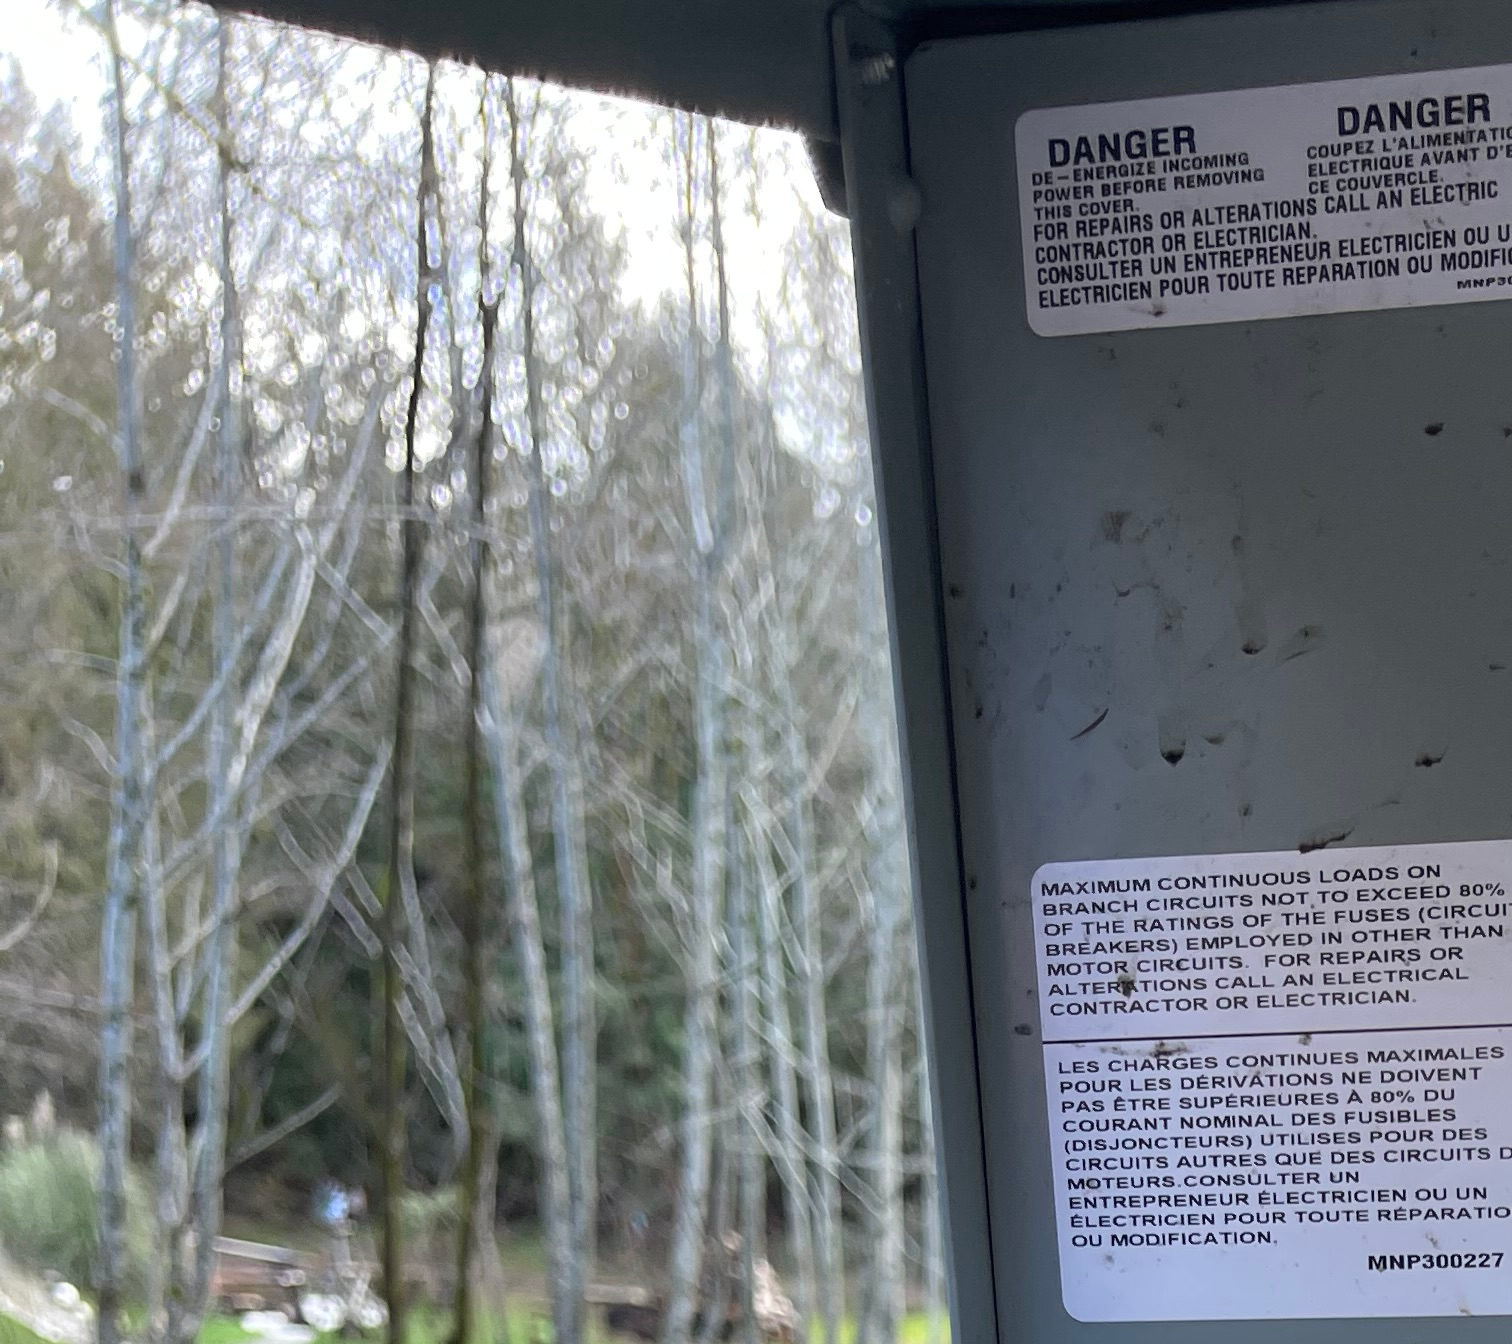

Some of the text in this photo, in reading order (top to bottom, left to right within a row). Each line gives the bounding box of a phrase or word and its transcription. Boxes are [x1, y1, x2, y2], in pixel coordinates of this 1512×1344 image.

[1337, 93, 1491, 137] DANGER
[1048, 125, 1197, 168] DANGER
[1163, 152, 1250, 174] INCOMING
[1306, 140, 1374, 160] COUPEZ
[1307, 153, 1414, 178] ELECTRIQUE
[1420, 147, 1480, 167] AVANT
[1033, 168, 1265, 204] POWER BEFORE REMOVING
[1308, 169, 1444, 195] CE COUVERCLE.
[1033, 198, 1134, 221] THIS COVER.
[1033, 180, 1498, 243] FOR REPAIRS OR ALTERATIONS CALL AN ELECTRIC
[1035, 221, 1318, 265] CONTRACTOR OR ELECTRICIAN.
[1038, 280, 1152, 309] ELECTRICIEN
[1159, 275, 1210, 298] POUR
[1216, 269, 1276, 292] TOUTE
[1282, 257, 1400, 286] REPARATION
[1407, 254, 1433, 275] OU
[1041, 864, 1441, 897] MAXIMUM CONTINUOUS LOADS ON
[1042, 882, 1505, 917] BRANCH CIRCUITS NOT TO EXCEED 80%
[1045, 924, 1503, 957] BREAKERS) EMPLOYED IN OTHER THAN
[1050, 989, 1417, 1016] CONTRACTOR OR ELECTRICIAN.
[1368, 1252, 1504, 1271] MNP300227
